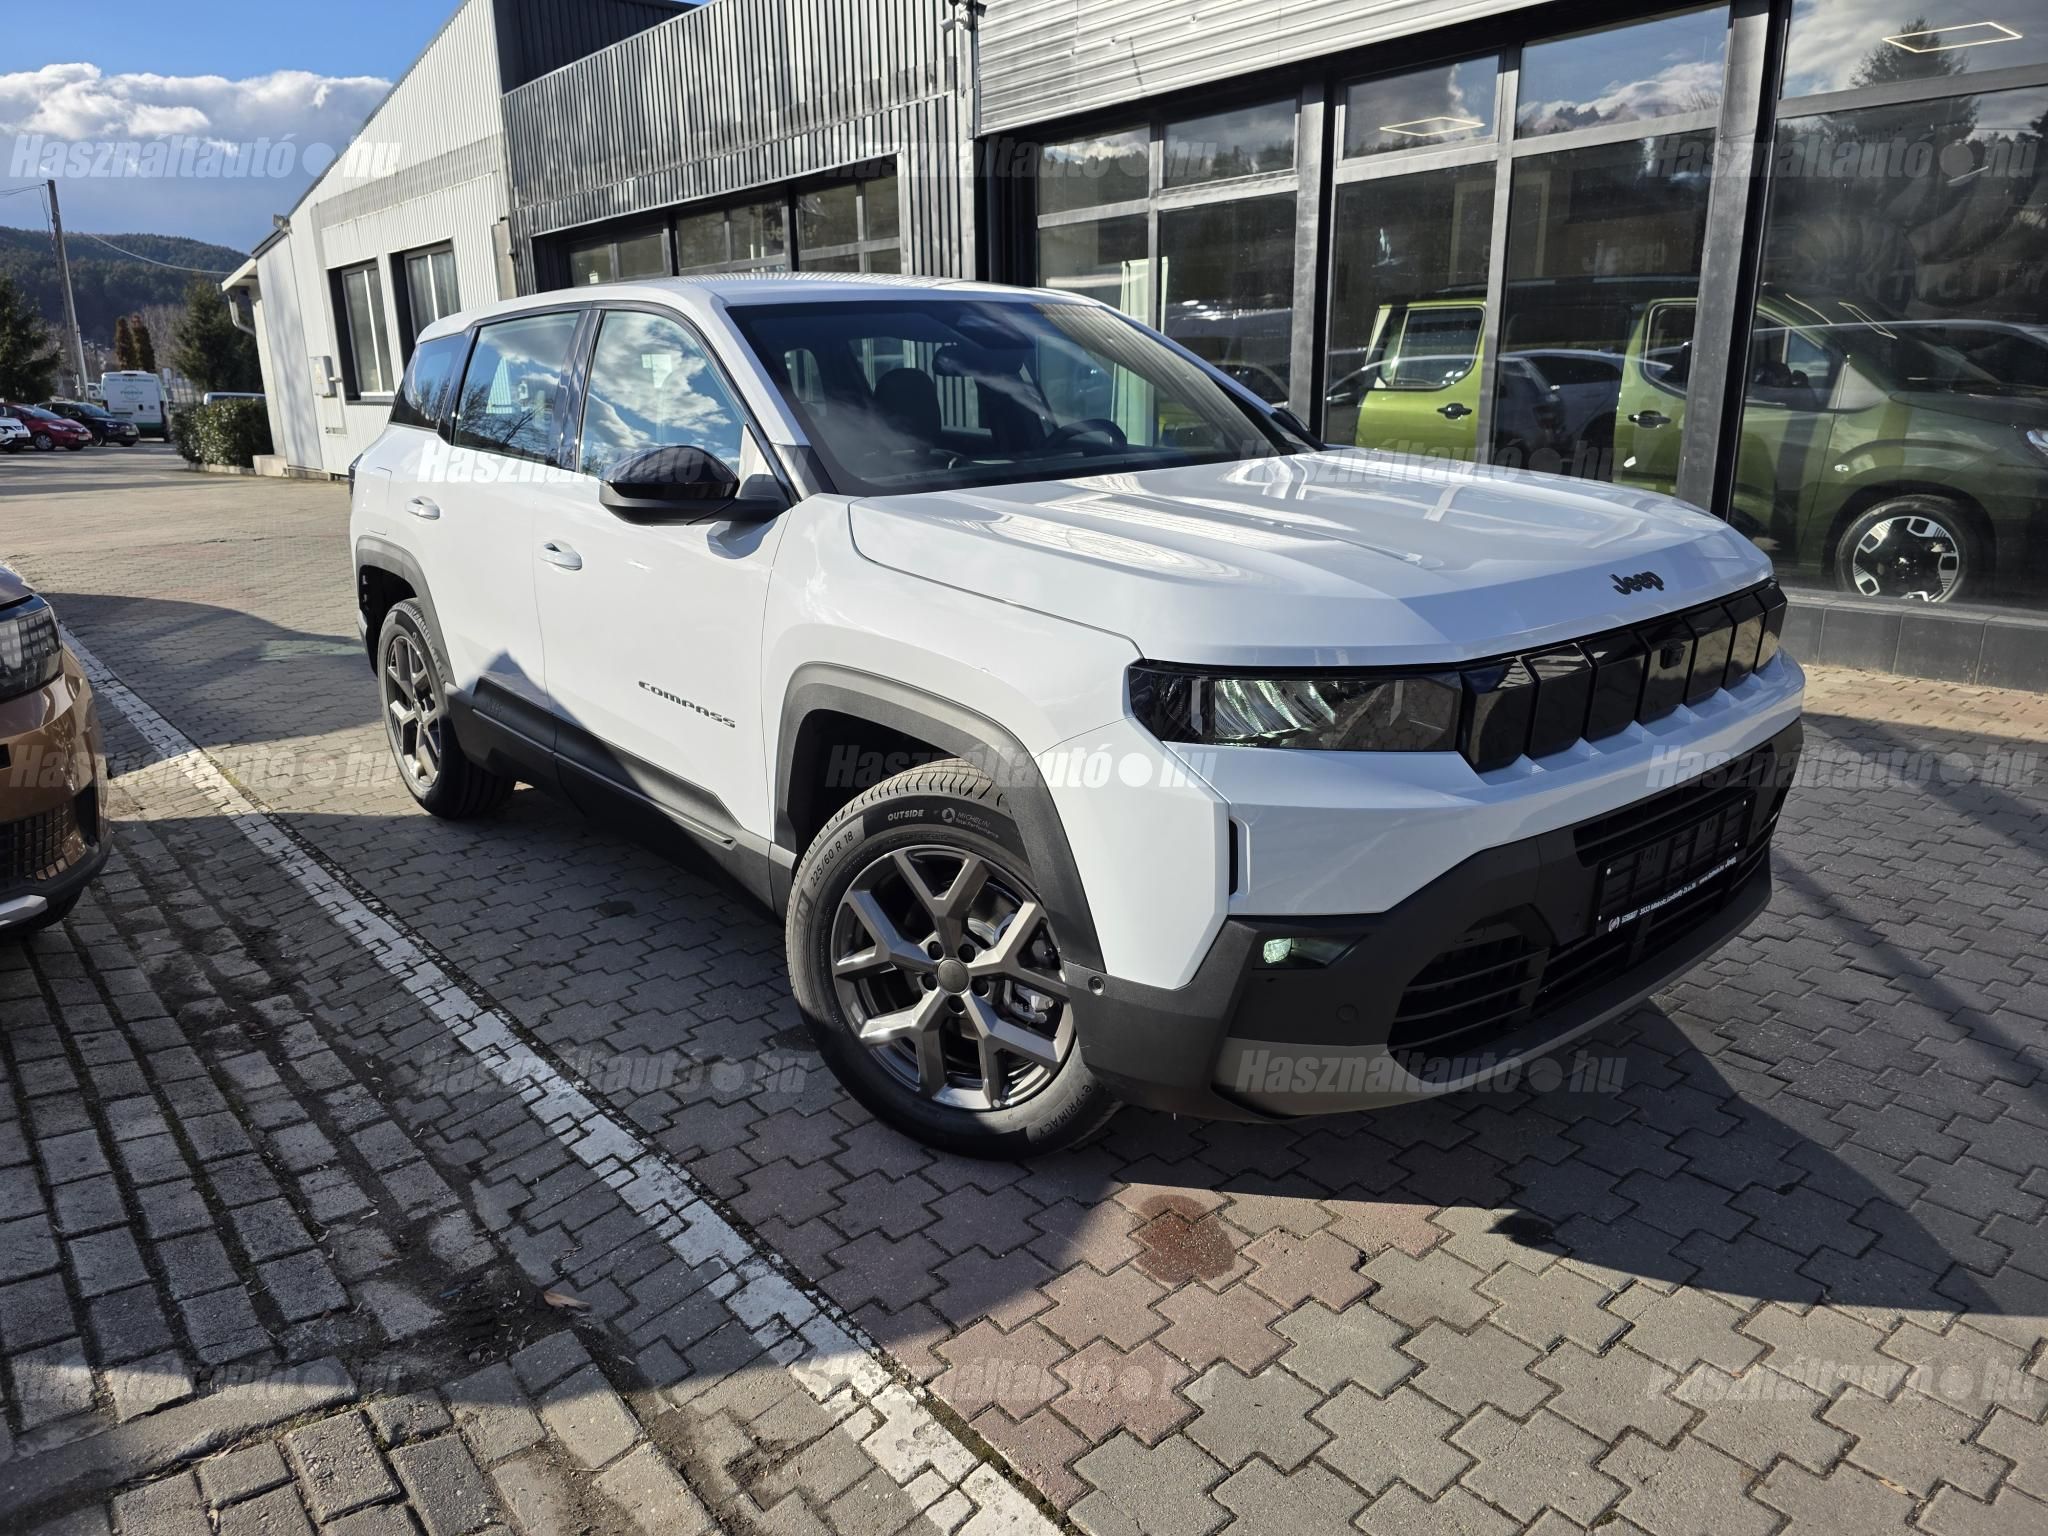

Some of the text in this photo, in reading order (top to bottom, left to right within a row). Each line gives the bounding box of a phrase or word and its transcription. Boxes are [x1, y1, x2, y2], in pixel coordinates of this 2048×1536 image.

[1609, 571, 1664, 595] Jeep
[888, 809, 924, 821] OUTSIDE
[957, 811, 991, 828] MICHELIN
[810, 830, 855, 889] 225/60 R 18
